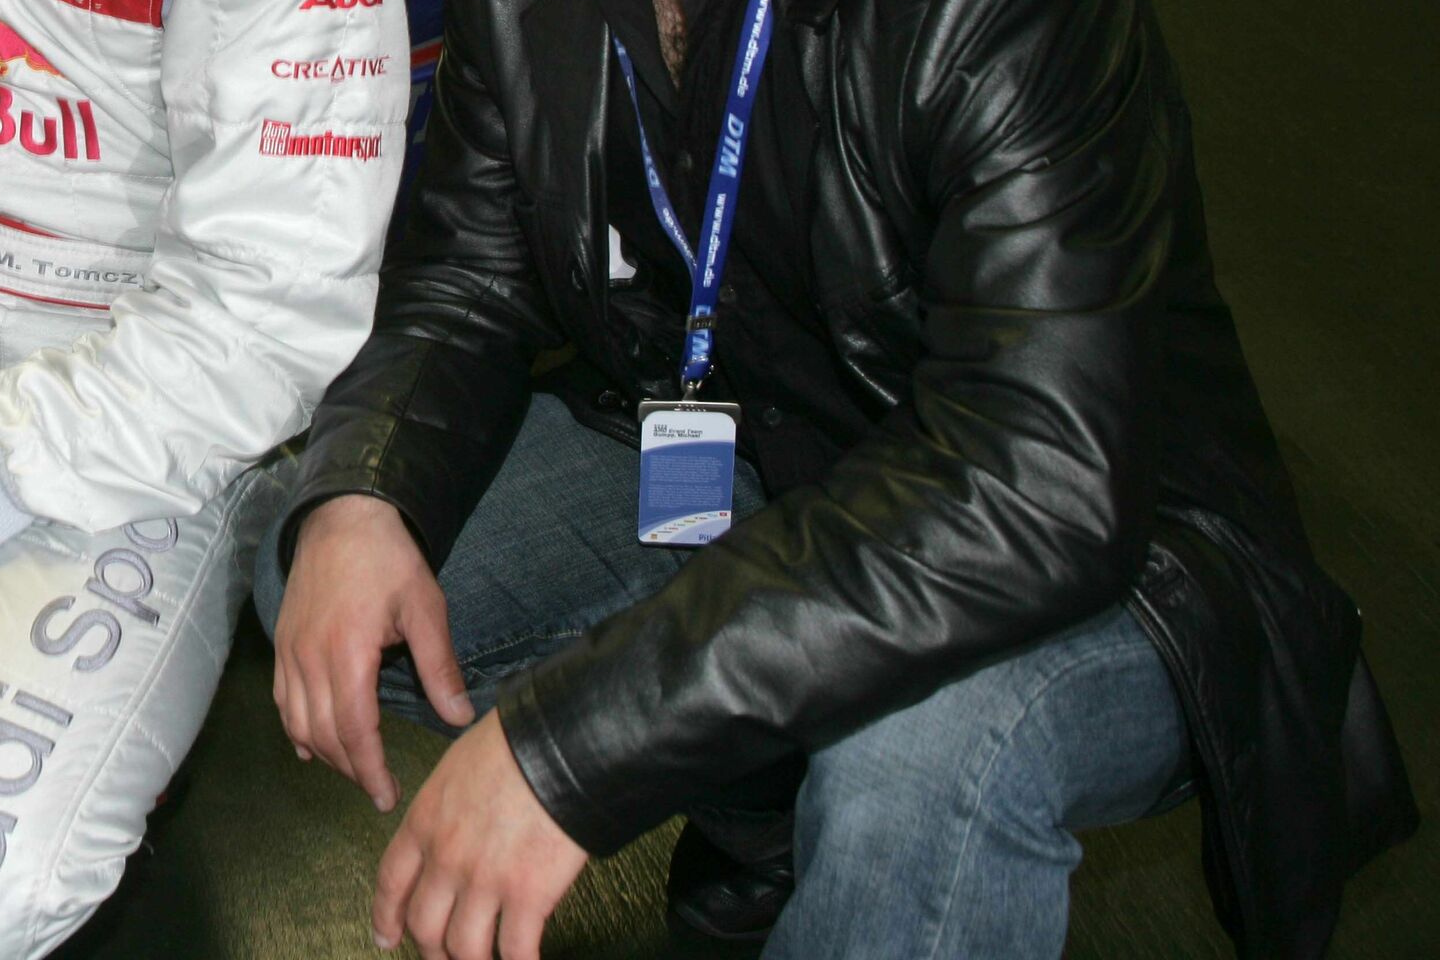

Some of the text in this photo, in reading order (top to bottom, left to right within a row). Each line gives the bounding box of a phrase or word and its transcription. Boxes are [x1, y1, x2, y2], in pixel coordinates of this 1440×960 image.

[270, 55, 390, 83] CREATIVE
[718, 113, 745, 178] DTM
[29, 518, 180, 673] Spo
